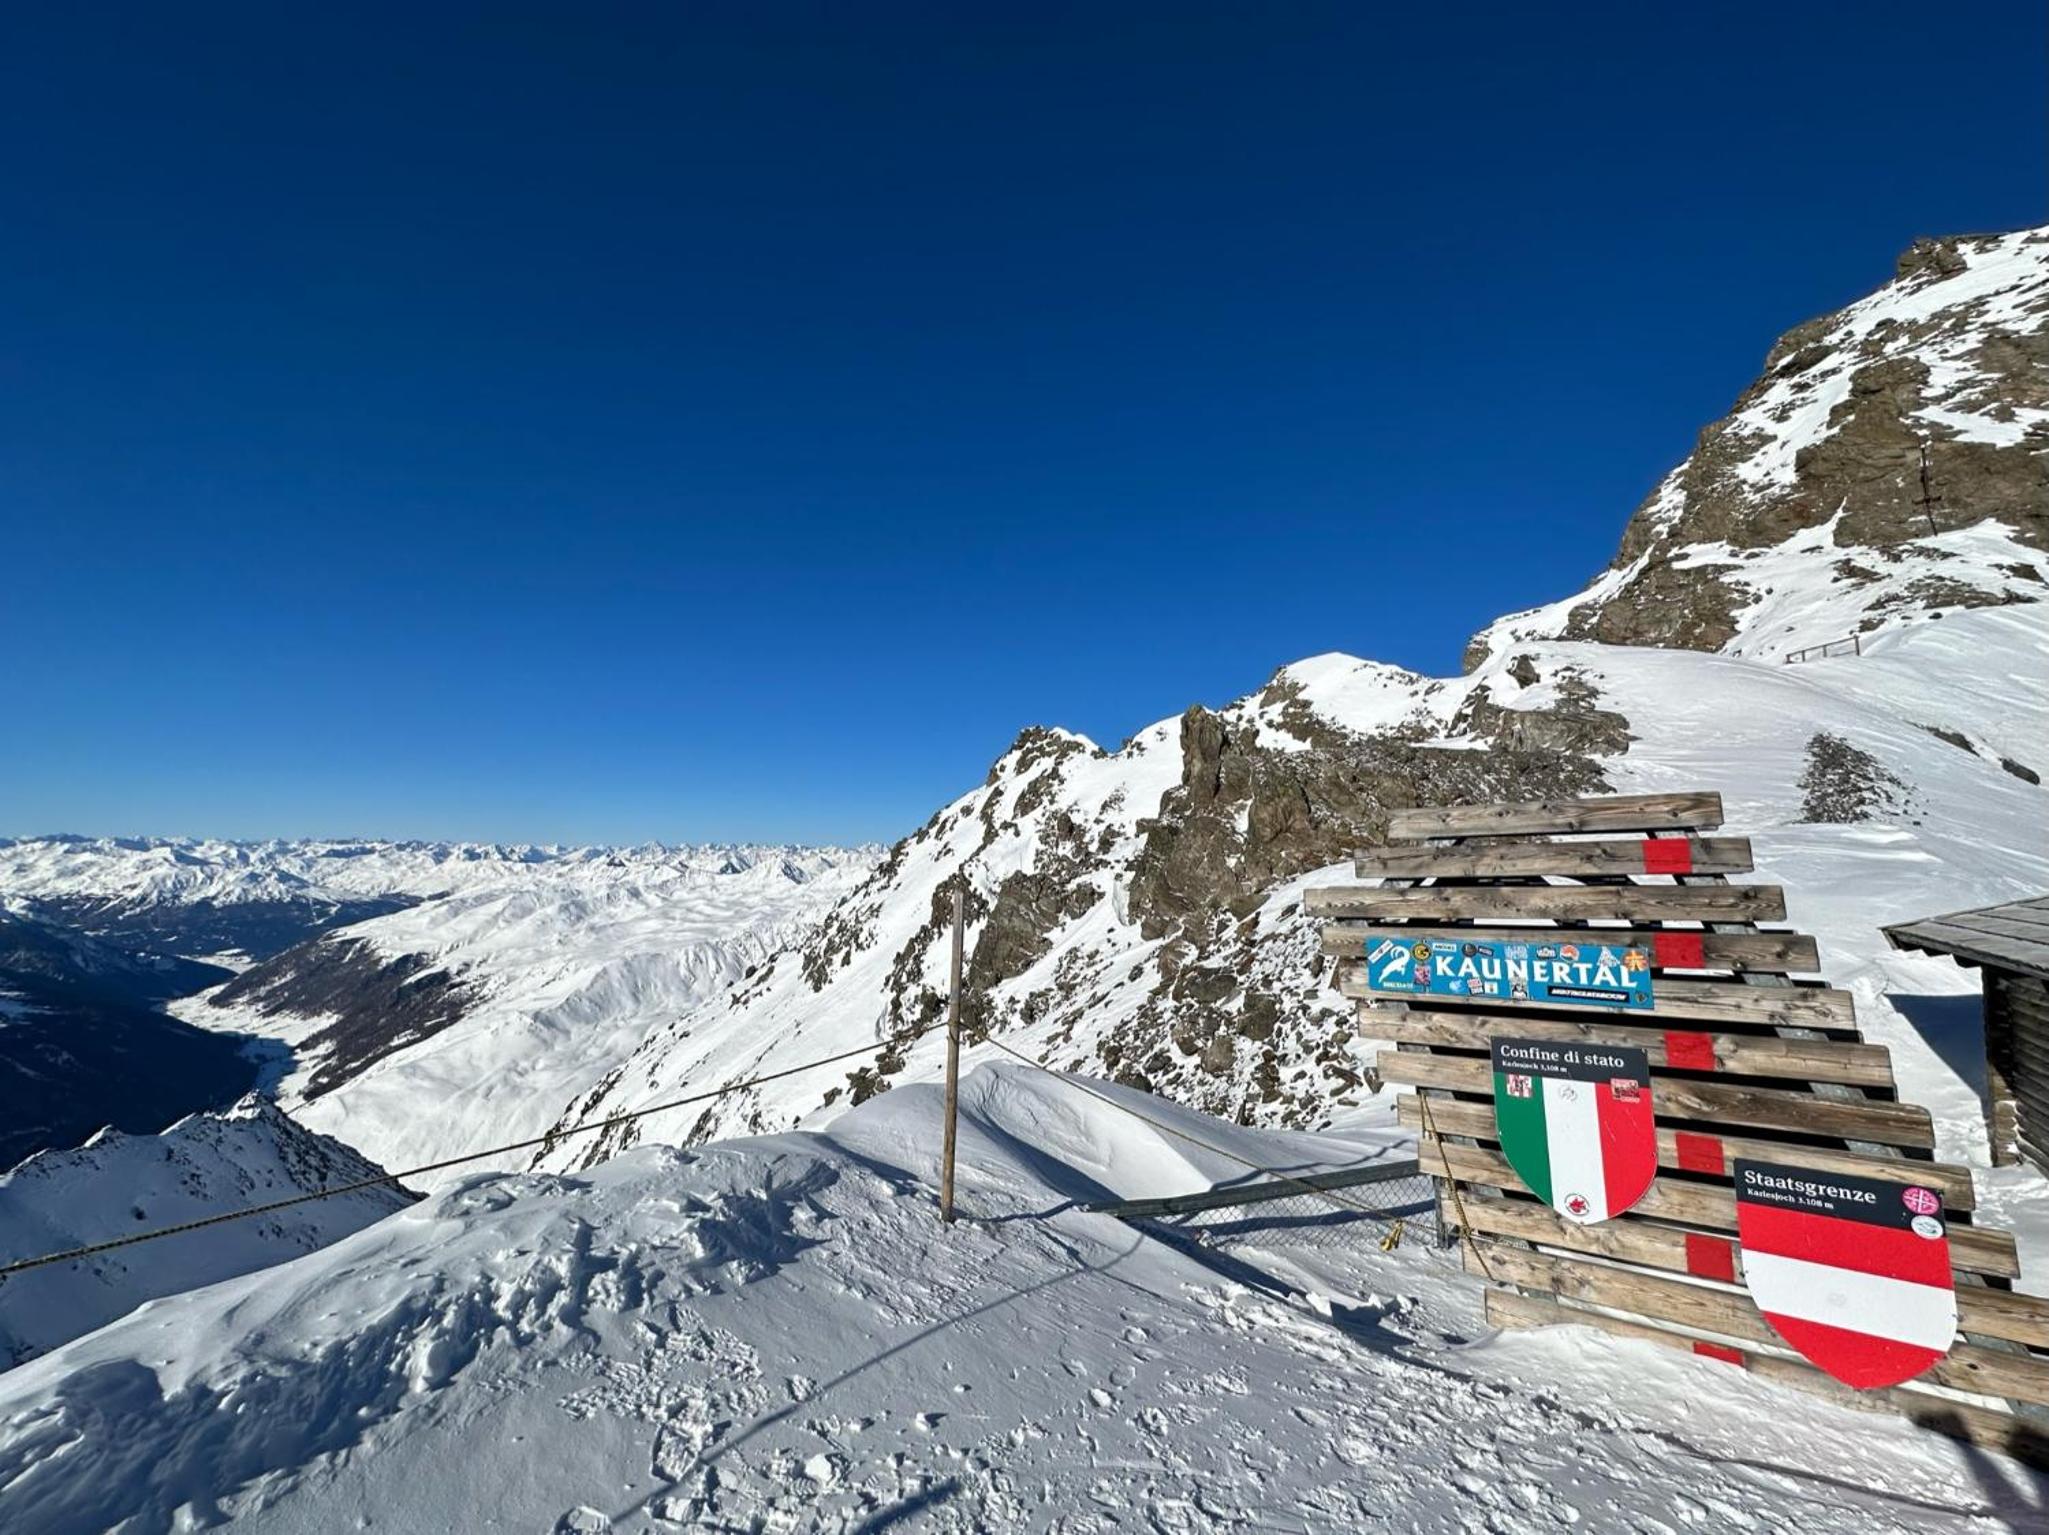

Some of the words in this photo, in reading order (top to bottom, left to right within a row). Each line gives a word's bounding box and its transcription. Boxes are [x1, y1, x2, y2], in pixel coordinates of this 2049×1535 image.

[1435, 955, 1638, 989] KAUNERTAL
[1500, 1044, 1559, 1061] Confine
[1564, 1050, 1580, 1064] di
[1584, 1053, 1625, 1068] stato
[1744, 1169, 1877, 1205] Staatsgrenze
[1746, 1187, 1796, 1203] Karlesjoch
[1824, 1202, 1834, 1210] m
